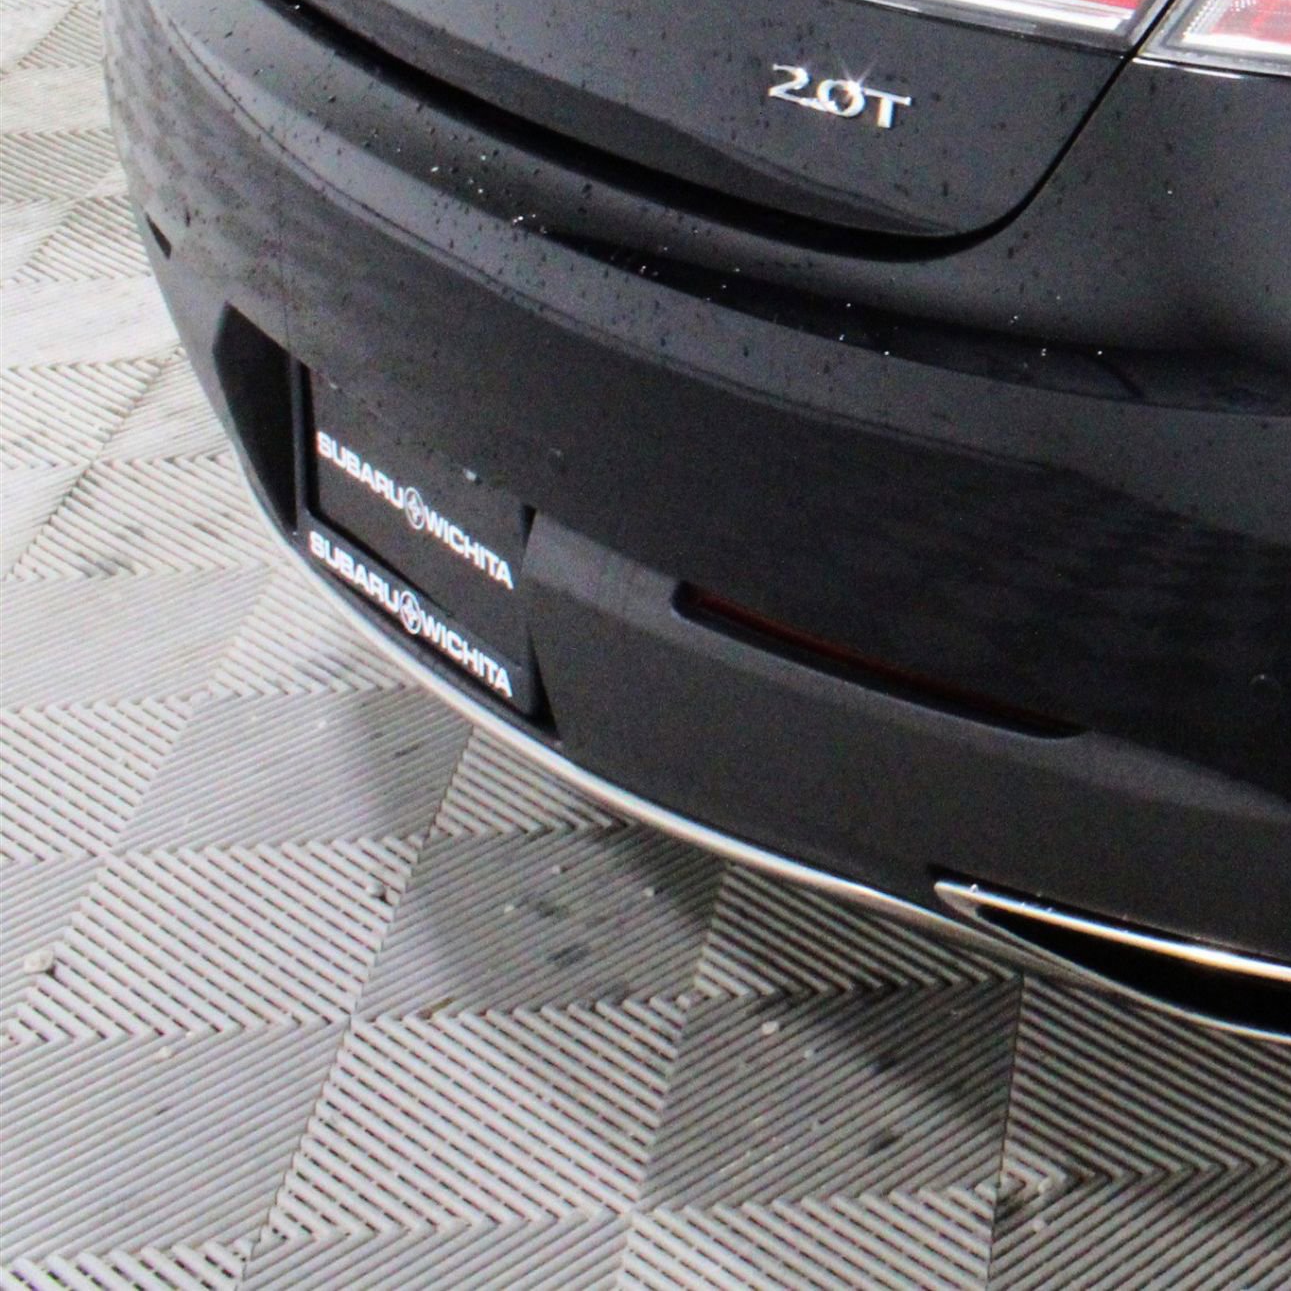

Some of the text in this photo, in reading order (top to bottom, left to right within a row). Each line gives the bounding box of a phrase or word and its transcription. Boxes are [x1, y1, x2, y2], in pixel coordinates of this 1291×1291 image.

[317, 430, 515, 591] SUBARU WICHITA
[309, 530, 514, 698] SUBARU WICHITA
